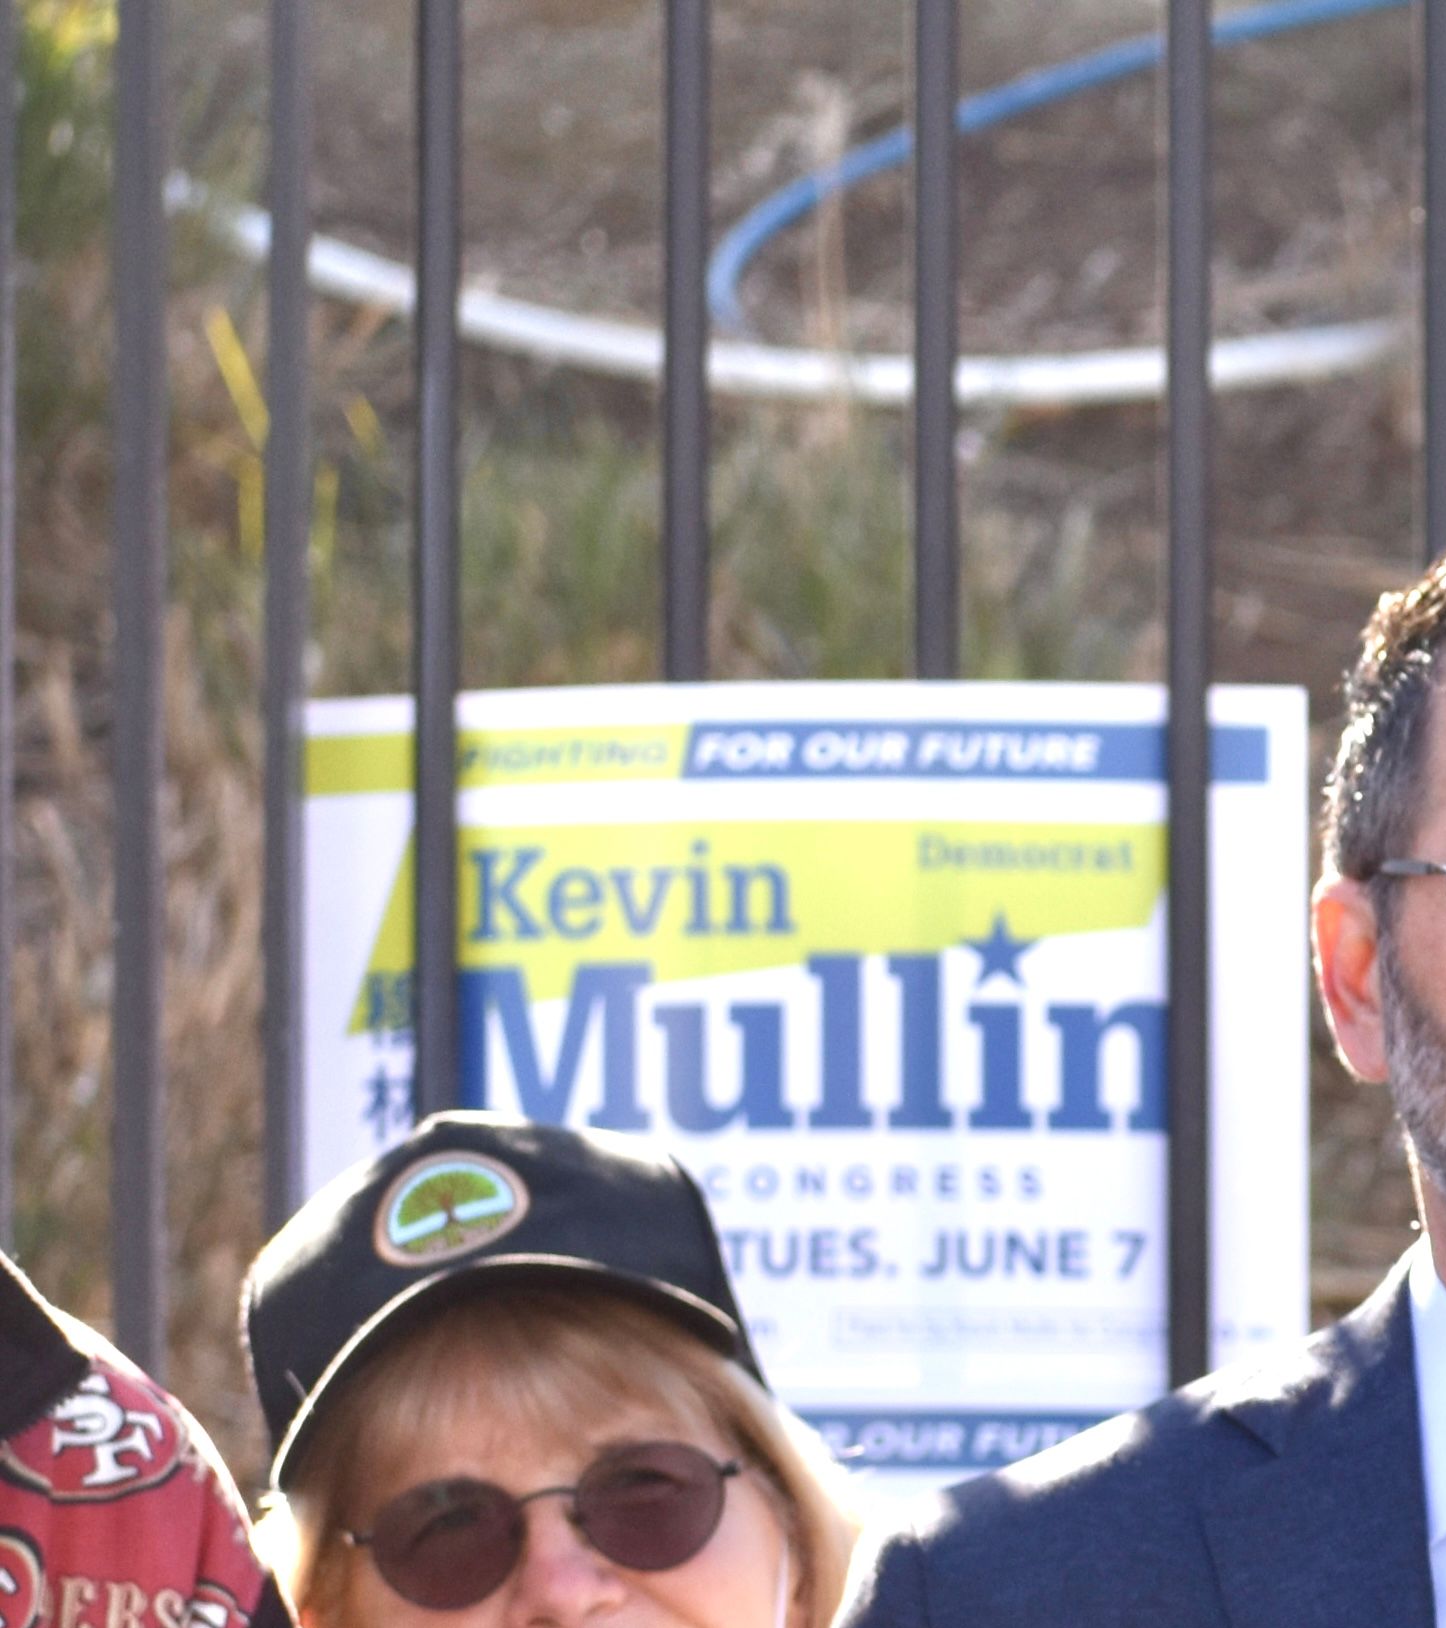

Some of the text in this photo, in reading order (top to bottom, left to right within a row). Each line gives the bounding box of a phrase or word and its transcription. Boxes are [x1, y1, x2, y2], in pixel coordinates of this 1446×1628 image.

[460, 730, 1102, 775] FIGHTING FOR OUR FUTURE
[917, 830, 1136, 874] Democrat
[468, 837, 798, 943] Kevin
[457, 904, 1168, 1133] Mullin
[700, 1163, 1045, 1200] CONGRESS
[722, 1228, 1149, 1280] TUES. JUNE 7
[857, 1418, 965, 1462] OUR
